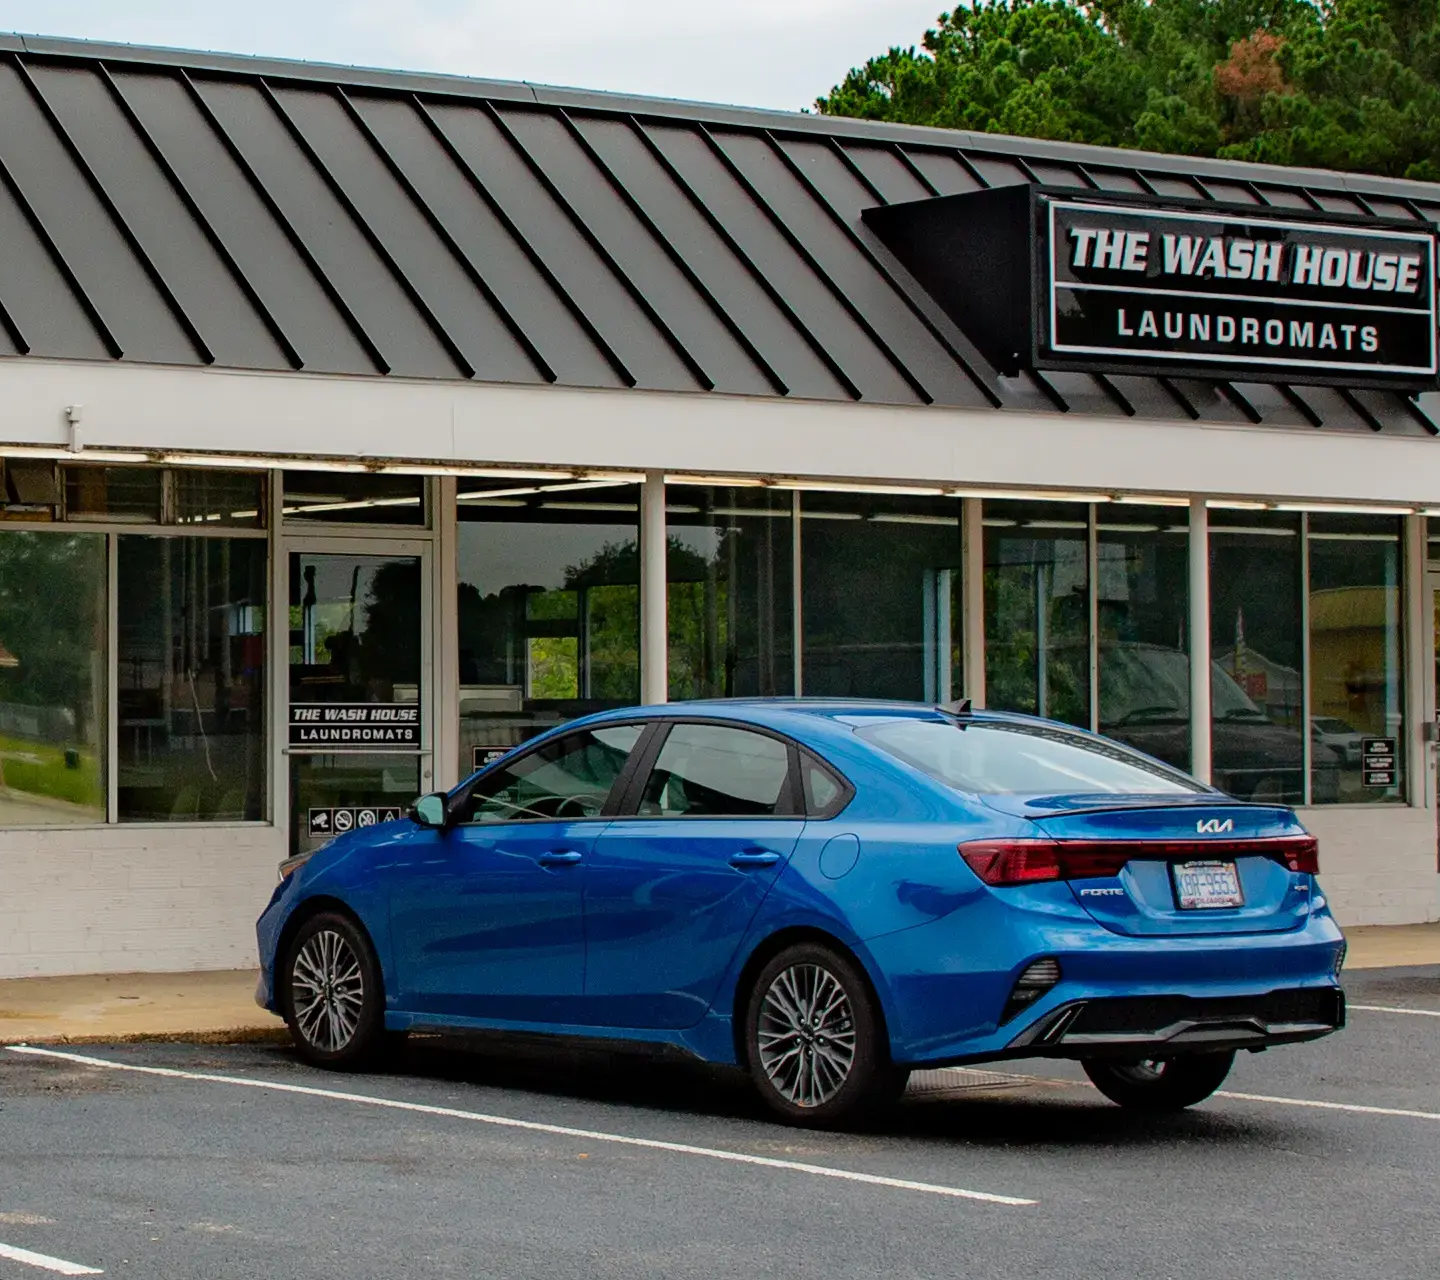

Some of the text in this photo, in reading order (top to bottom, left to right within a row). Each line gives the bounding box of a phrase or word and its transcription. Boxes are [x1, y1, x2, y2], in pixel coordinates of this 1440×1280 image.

[1069, 228, 1420, 295] THE WASH HOUSE
[1118, 308, 1380, 353] LAUNDROMATS
[293, 708, 418, 721] THE WASH HOUSE
[300, 728, 413, 740] LAUNDROMATS
[1196, 819, 1233, 833] KIA
[1080, 888, 1124, 896] FORTE
